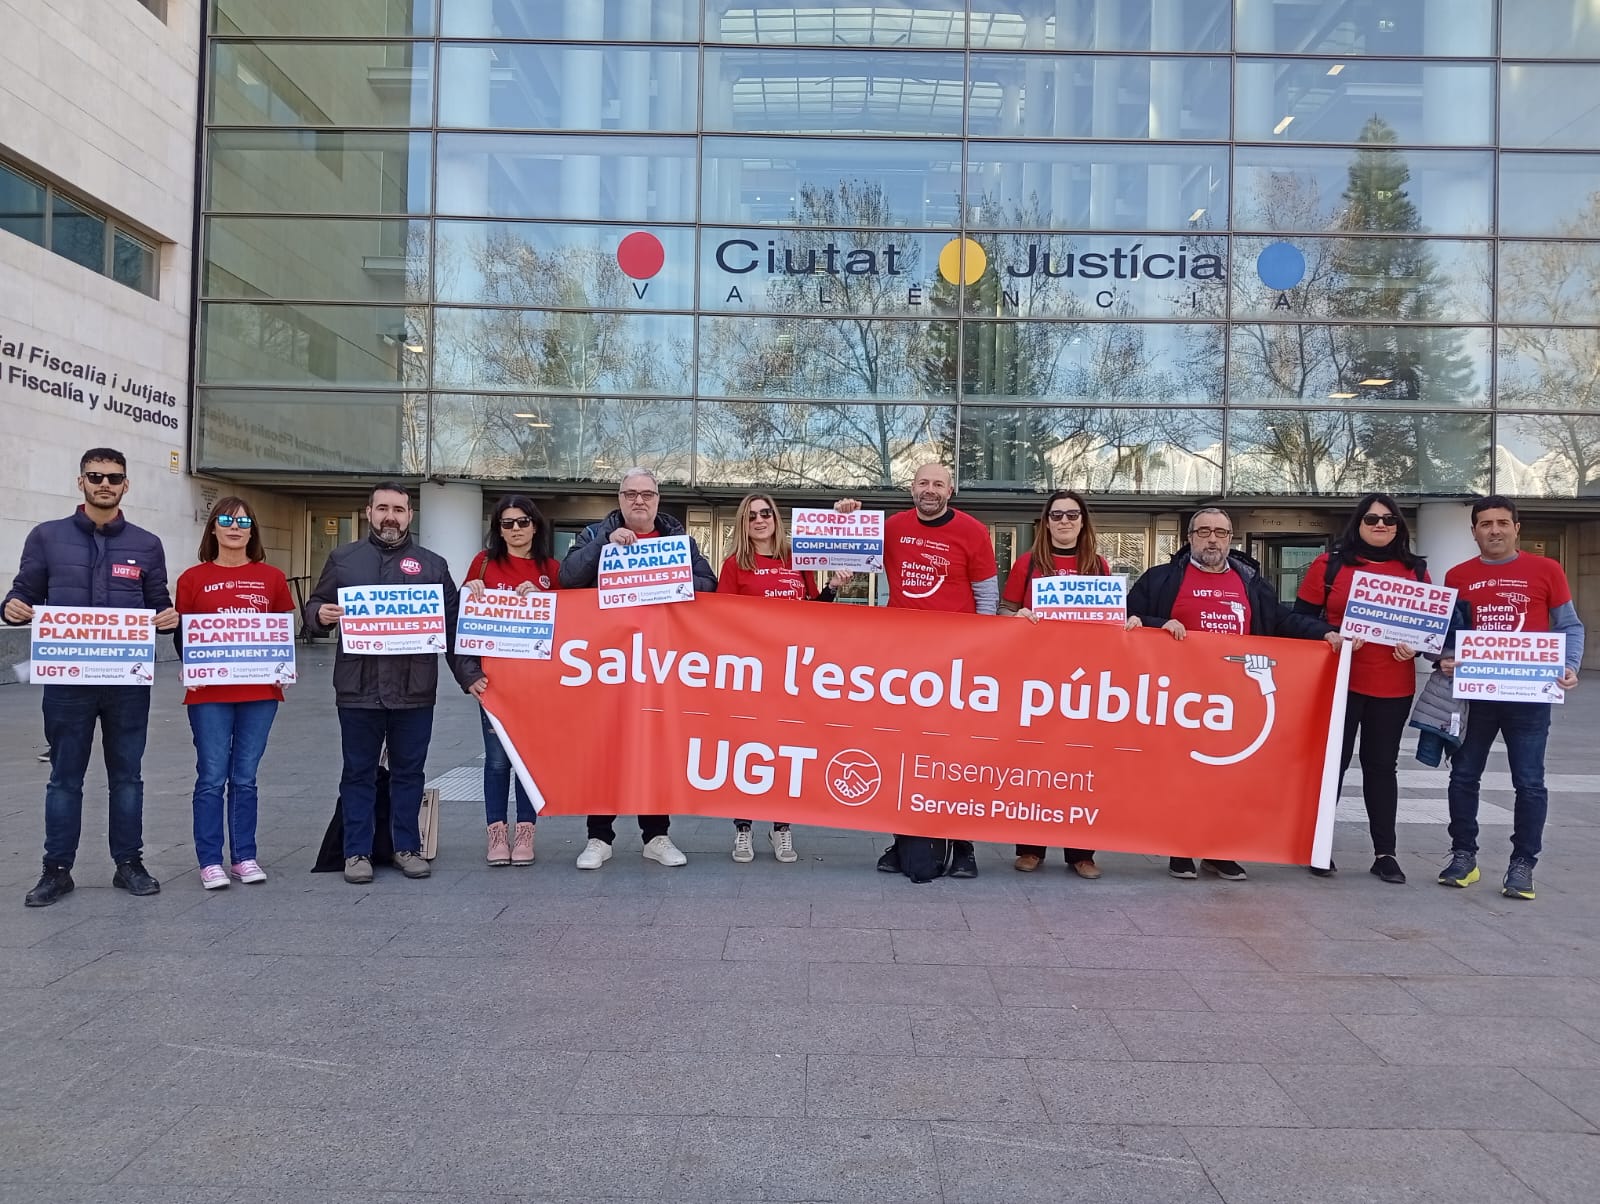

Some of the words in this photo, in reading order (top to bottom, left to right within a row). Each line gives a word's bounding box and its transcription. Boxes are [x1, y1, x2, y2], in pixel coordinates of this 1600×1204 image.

[715, 239, 901, 275] Ciutat
[1007, 243, 1226, 280] Justícia
[29, 346, 106, 385] Fiscalia
[111, 373, 118, 389] i
[121, 378, 176, 407] Jutjats
[9, 365, 84, 403] Fiscalía
[89, 393, 99, 410] y
[103, 395, 178, 429] Juzgados
[796, 513, 856, 524] ACORDS
[860, 515, 880, 525] DE
[796, 525, 880, 536] PLANTILLES
[796, 541, 862, 550] COMPLIMENT
[900, 536, 916, 544] UGT
[604, 547, 620, 558] LA
[622, 541, 686, 556] JUSTÍCIA
[603, 560, 624, 570] HA
[628, 553, 687, 568] PARLAT
[795, 557, 817, 565] UGT
[901, 561, 934, 573] Salvem
[601, 572, 669, 586] PLANTILLES
[671, 570, 690, 580] JA!
[204, 582, 224, 592] UGT
[1037, 582, 1055, 592] LA
[1059, 579, 1122, 591] JUSTÍCIA
[1357, 577, 1425, 598] ACORDS
[1428, 590, 1451, 602] DE
[1469, 580, 1487, 590] UGT
[344, 592, 365, 601] LA
[369, 588, 439, 601] JUSTÍCIA
[603, 594, 626, 604] UGT
[764, 589, 795, 597] Salvem
[1193, 589, 1212, 597] UGT
[466, 593, 528, 607] ACORDS
[531, 597, 551, 608] DE
[1037, 594, 1059, 605] HA
[1064, 594, 1122, 605] PARLAT
[1354, 589, 1449, 615] PLANTILLES
[345, 604, 370, 615] HA
[375, 603, 440, 615] PARLAT
[464, 605, 550, 621] PLANTILLES
[1476, 604, 1513, 613] Salvem
[40, 612, 119, 626] ACORDS
[124, 614, 149, 626] DE
[1036, 612, 1104, 620] PLANTILLES
[1106, 612, 1124, 620] JA!
[1200, 611, 1235, 620] Salvem
[1350, 606, 1424, 625] COMPLIMENT
[1425, 621, 1444, 630] JA!
[1476, 613, 1514, 622] l'escola
[188, 618, 261, 630] ACORDS
[266, 618, 289, 629] DE
[344, 622, 419, 631] PLANTILLES
[422, 621, 442, 630] JA!
[463, 622, 532, 634] COMPLIMENT
[1201, 620, 1236, 630] l'escola
[1345, 622, 1371, 634] UGT
[1476, 622, 1512, 631] pública
[39, 627, 149, 640] PLANTILLES
[188, 632, 289, 644] PLANTILLES
[347, 640, 371, 650] UGT
[459, 638, 484, 649] UGT
[1461, 636, 1531, 648] ACORDS
[1536, 638, 1559, 649] DE
[38, 646, 126, 656] COMPLIMENT
[128, 648, 149, 657] JA!
[188, 649, 269, 658] COMPLIMENT
[271, 649, 290, 657] JA!
[1461, 649, 1560, 662] PLANTILLES
[36, 665, 66, 677] UGT
[187, 668, 215, 678] UGT
[1460, 666, 1538, 677] COMPLIMENT
[1540, 669, 1559, 677] JA!
[559, 632, 763, 692] Salvem
[1019, 667, 1235, 730] pública
[1458, 683, 1484, 693] UGT
[686, 737, 818, 798] UGT
[914, 754, 1095, 792] Ensenyament
[910, 793, 985, 817] Serveis
[990, 800, 1064, 823] Públics
[1069, 806, 1099, 825] PV
